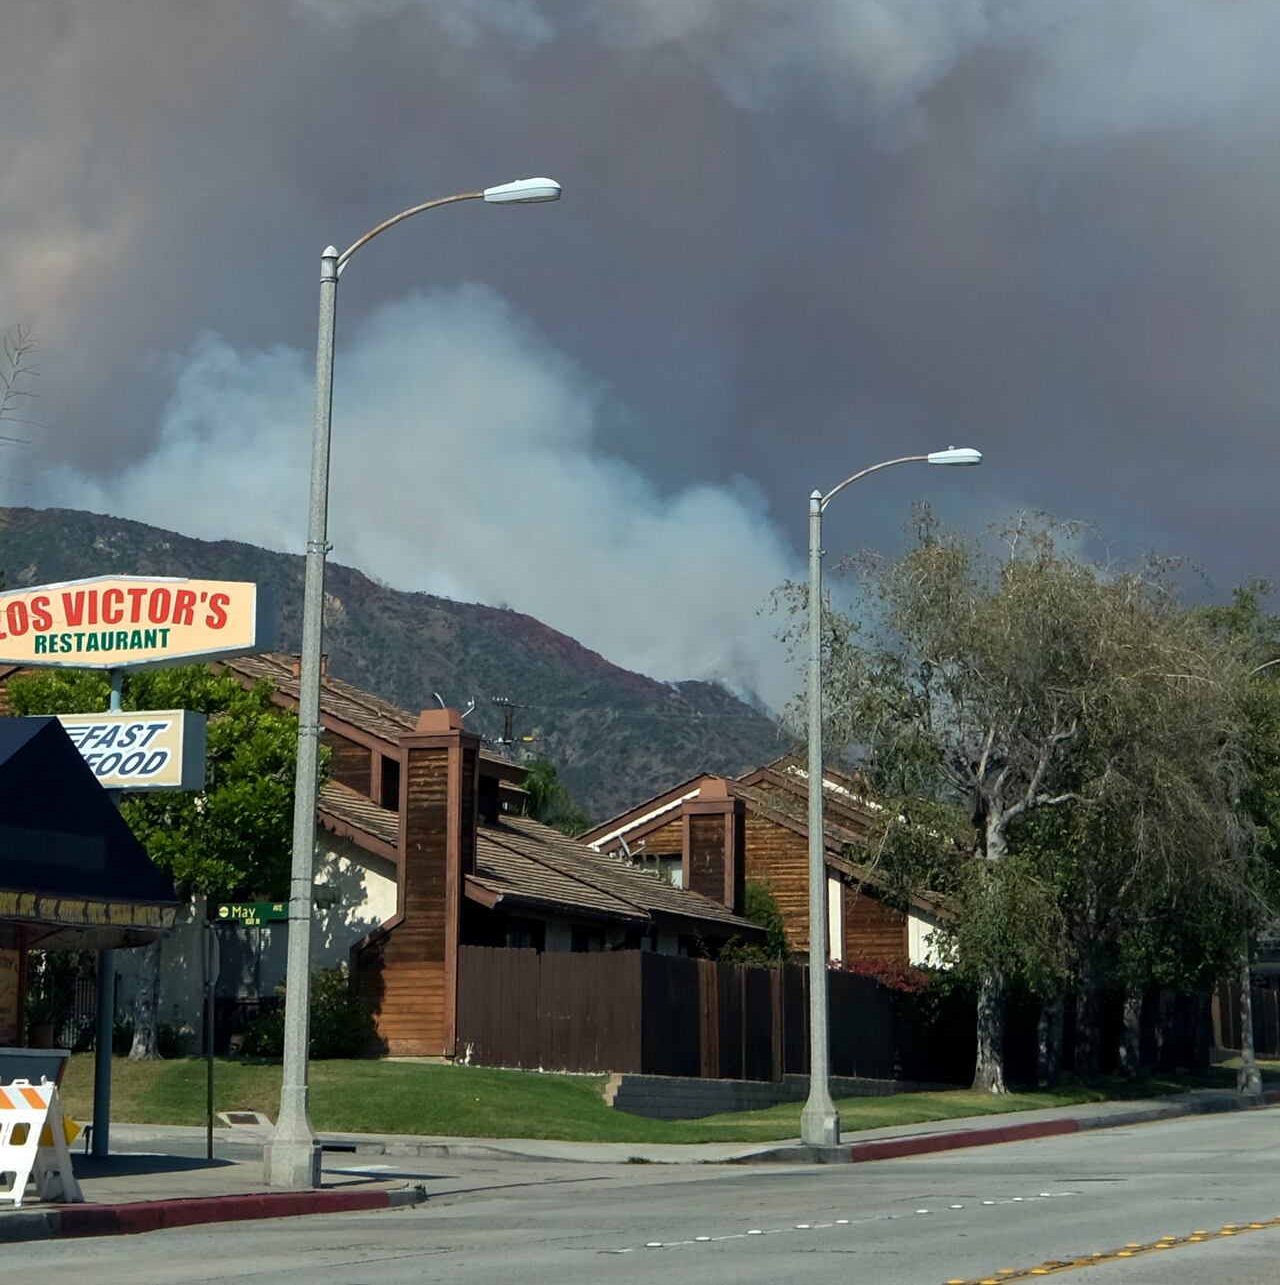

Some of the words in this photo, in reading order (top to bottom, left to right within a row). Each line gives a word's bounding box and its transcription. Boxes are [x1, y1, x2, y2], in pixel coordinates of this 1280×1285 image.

[61, 587, 231, 630] VICTOR'S
[34, 628, 171, 654] RESTAURANT
[77, 723, 169, 749] FAST
[87, 751, 168, 777] FOOD
[232, 906, 256, 919] May
